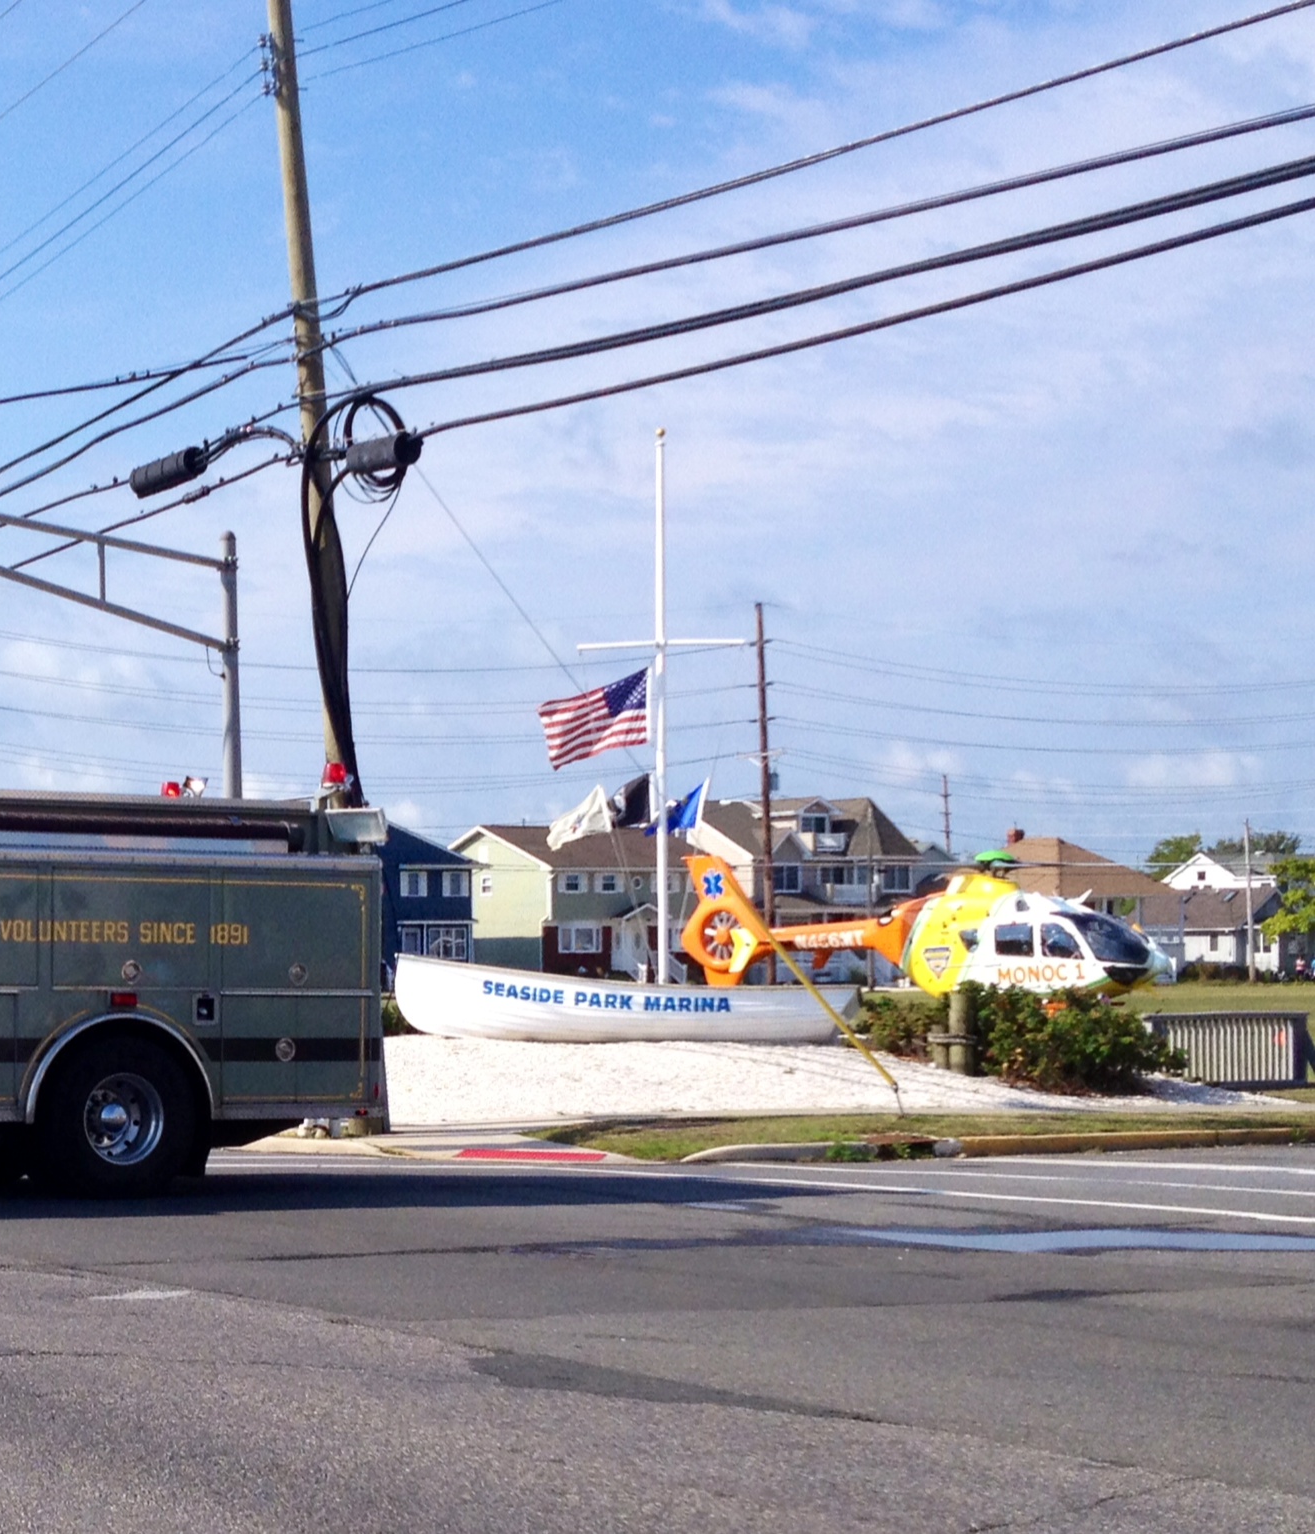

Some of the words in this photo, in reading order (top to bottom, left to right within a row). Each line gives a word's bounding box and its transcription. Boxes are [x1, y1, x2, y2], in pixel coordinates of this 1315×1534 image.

[0, 919, 129, 943] VOLUNTEERS
[139, 921, 196, 944] SINCE
[210, 923, 249, 945] 1891
[997, 963, 1068, 985] MONOC
[1075, 963, 1085, 980] 1
[482, 979, 565, 1005] SEASIDE
[573, 991, 633, 1010] PARK
[643, 996, 732, 1013] MARINA
